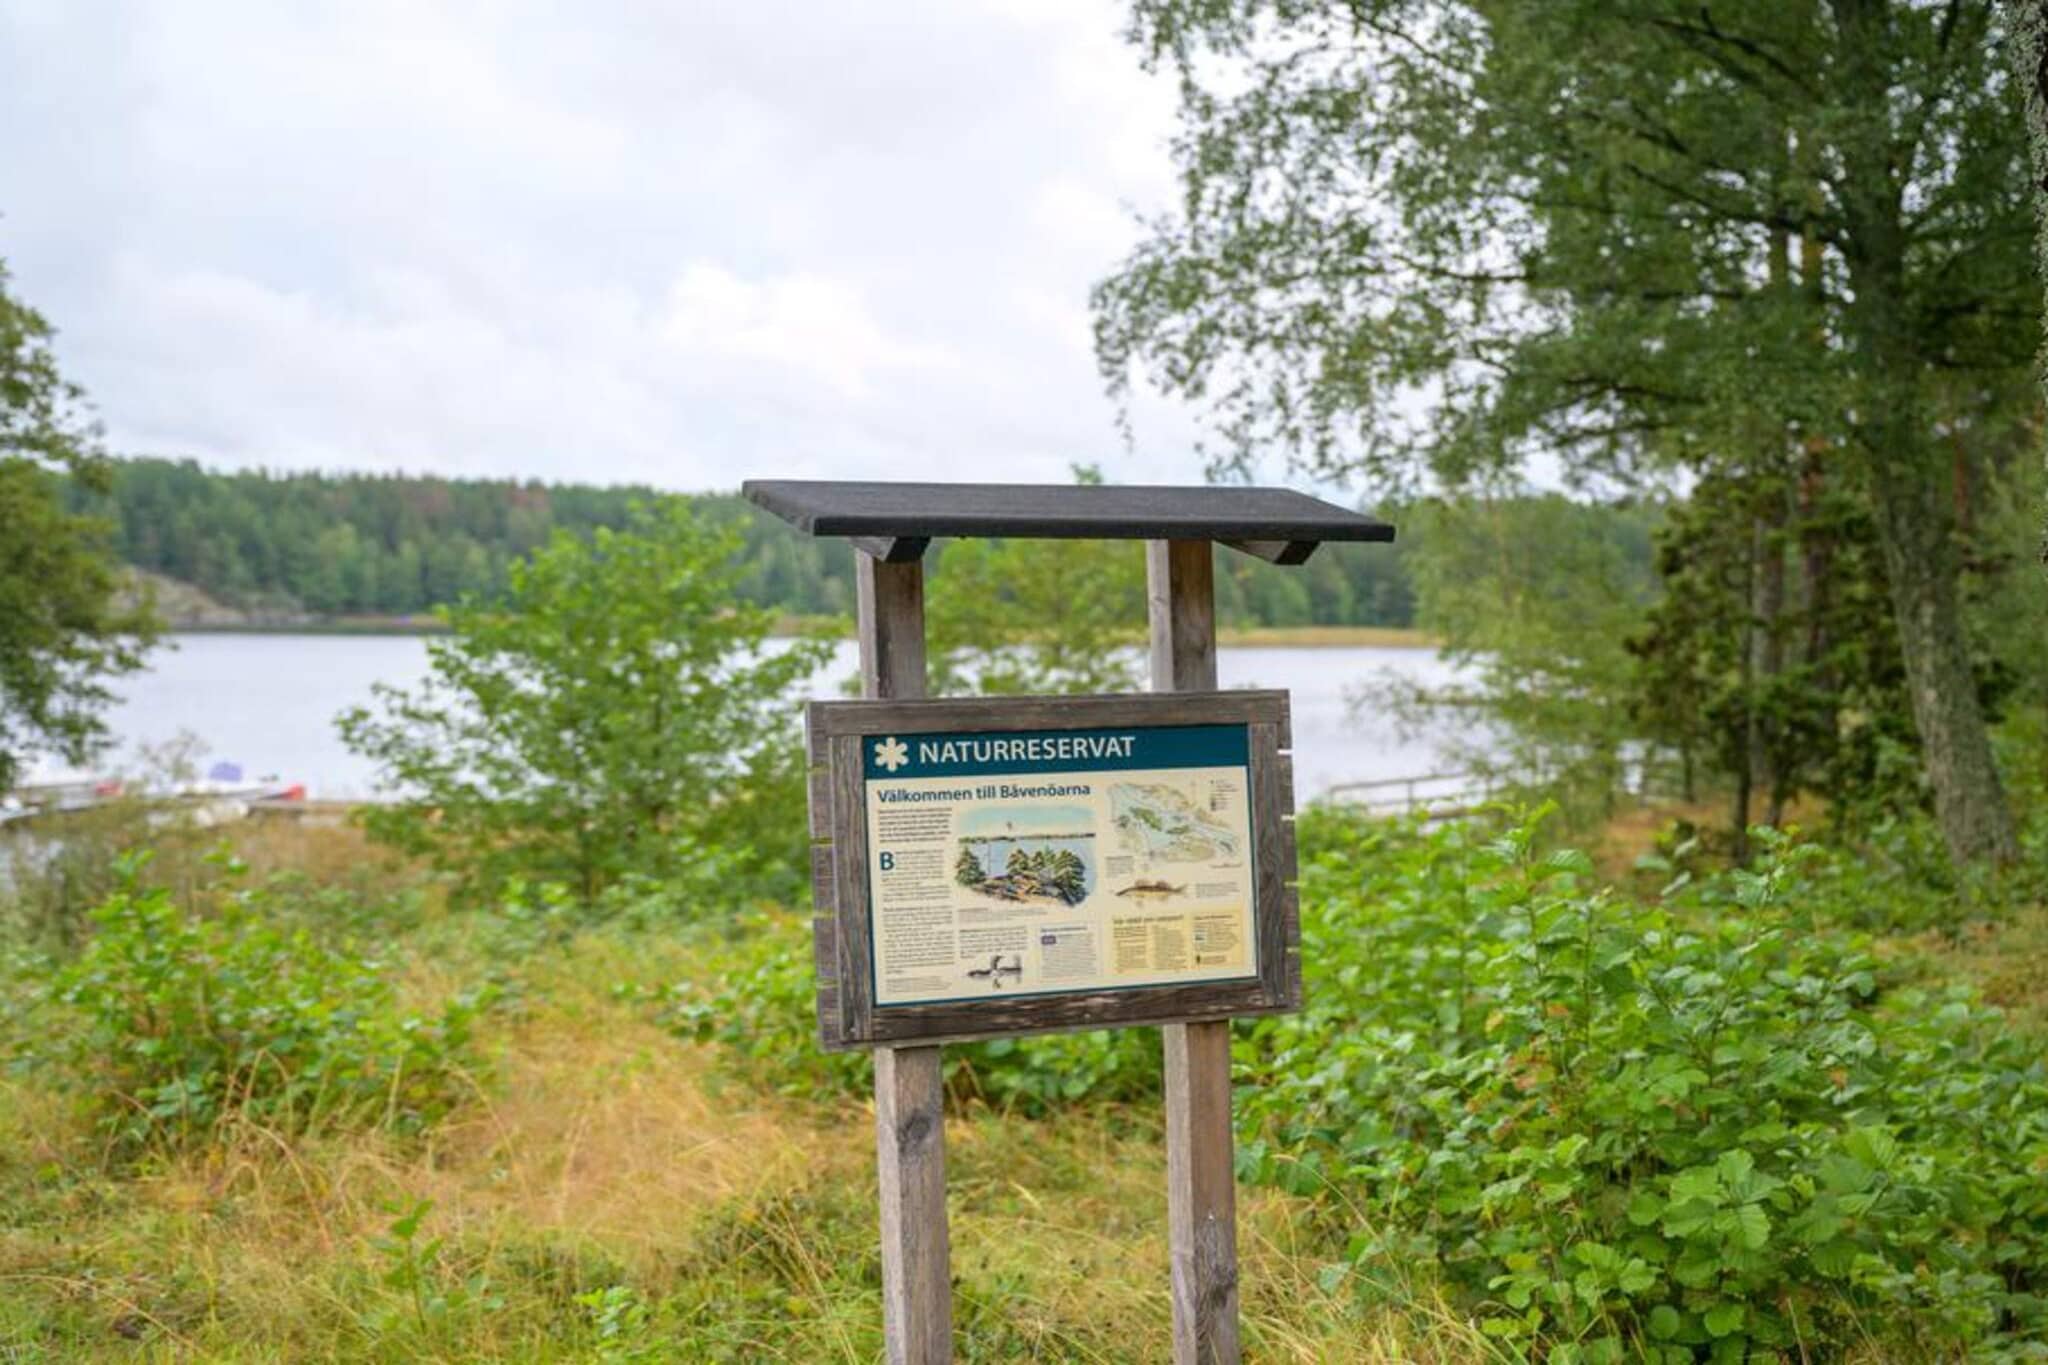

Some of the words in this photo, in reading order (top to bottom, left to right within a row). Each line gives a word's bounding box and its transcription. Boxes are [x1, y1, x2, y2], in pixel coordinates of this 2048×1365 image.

[919, 736, 1135, 764] NATURRESERVAT
[878, 785, 972, 803] Välkommen
[976, 784, 996, 800] till
[1000, 782, 1091, 799] Båvenöarna
